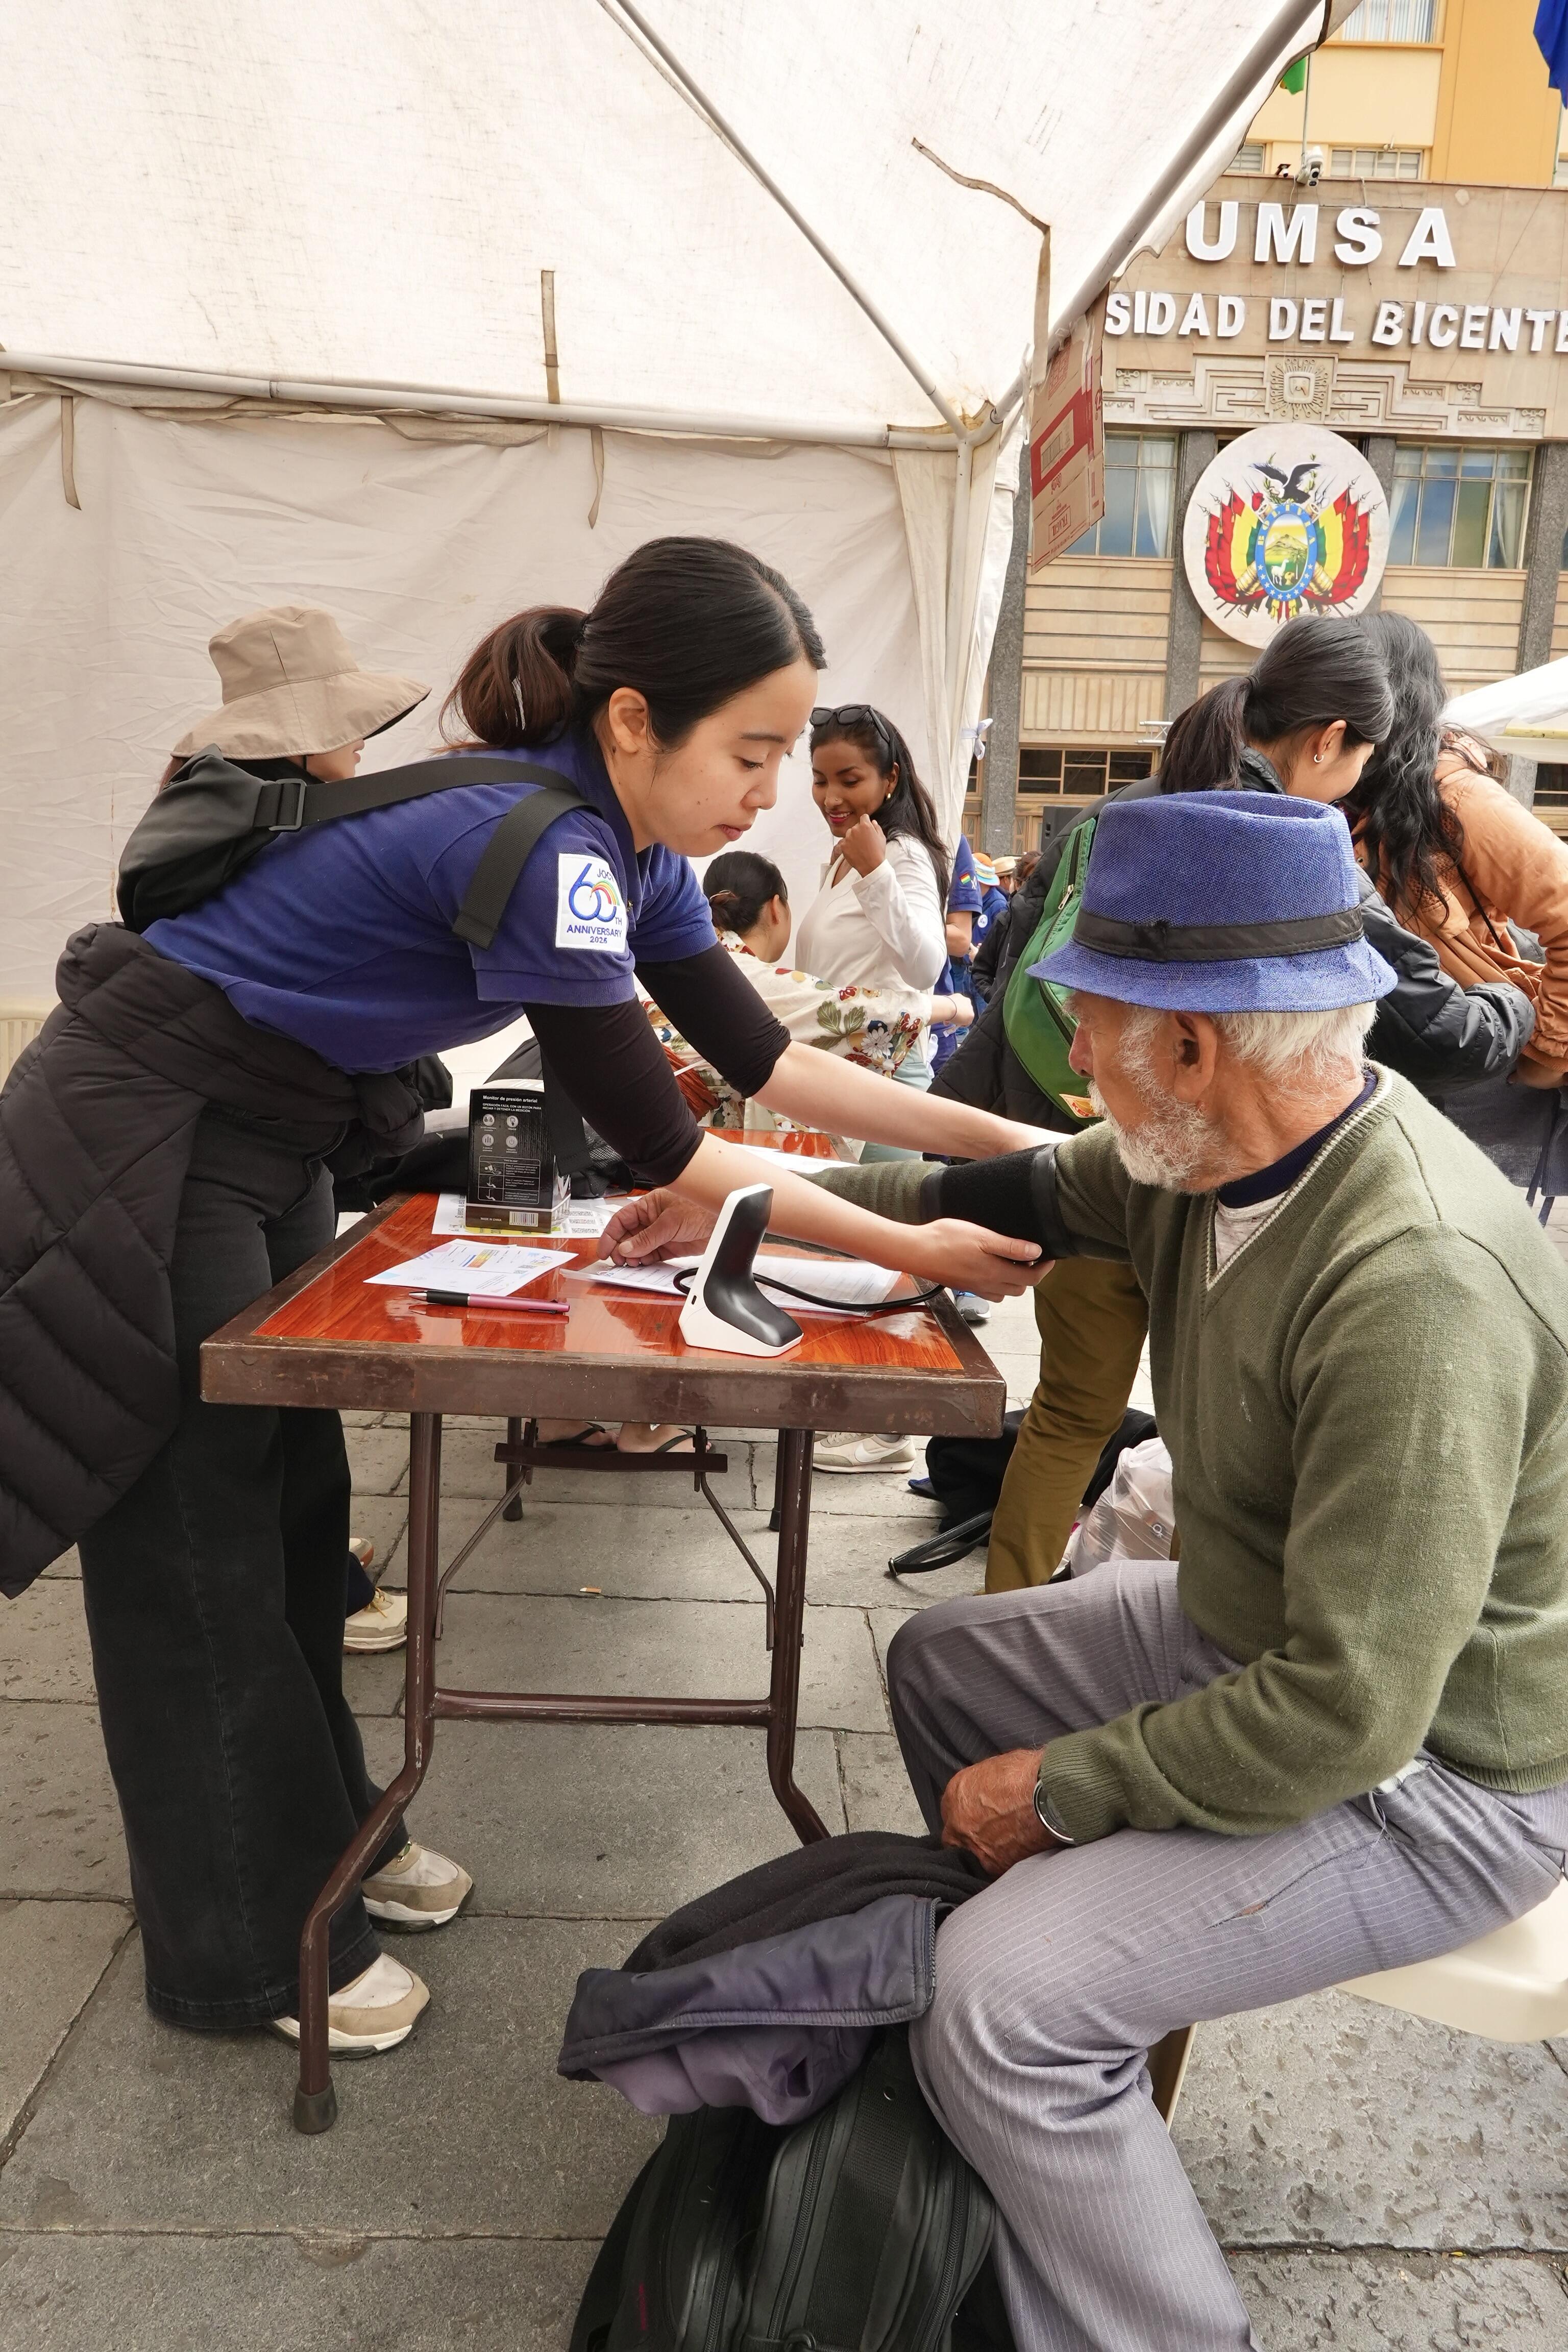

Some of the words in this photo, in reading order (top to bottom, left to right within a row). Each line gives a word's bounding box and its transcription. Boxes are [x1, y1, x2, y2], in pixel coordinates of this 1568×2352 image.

[1186, 201, 1456, 267] UMSA
[1106, 291, 1245, 337] SIDAD
[1269, 298, 1354, 340] DEL
[567, 924, 622, 938] ANNIVERSARY
